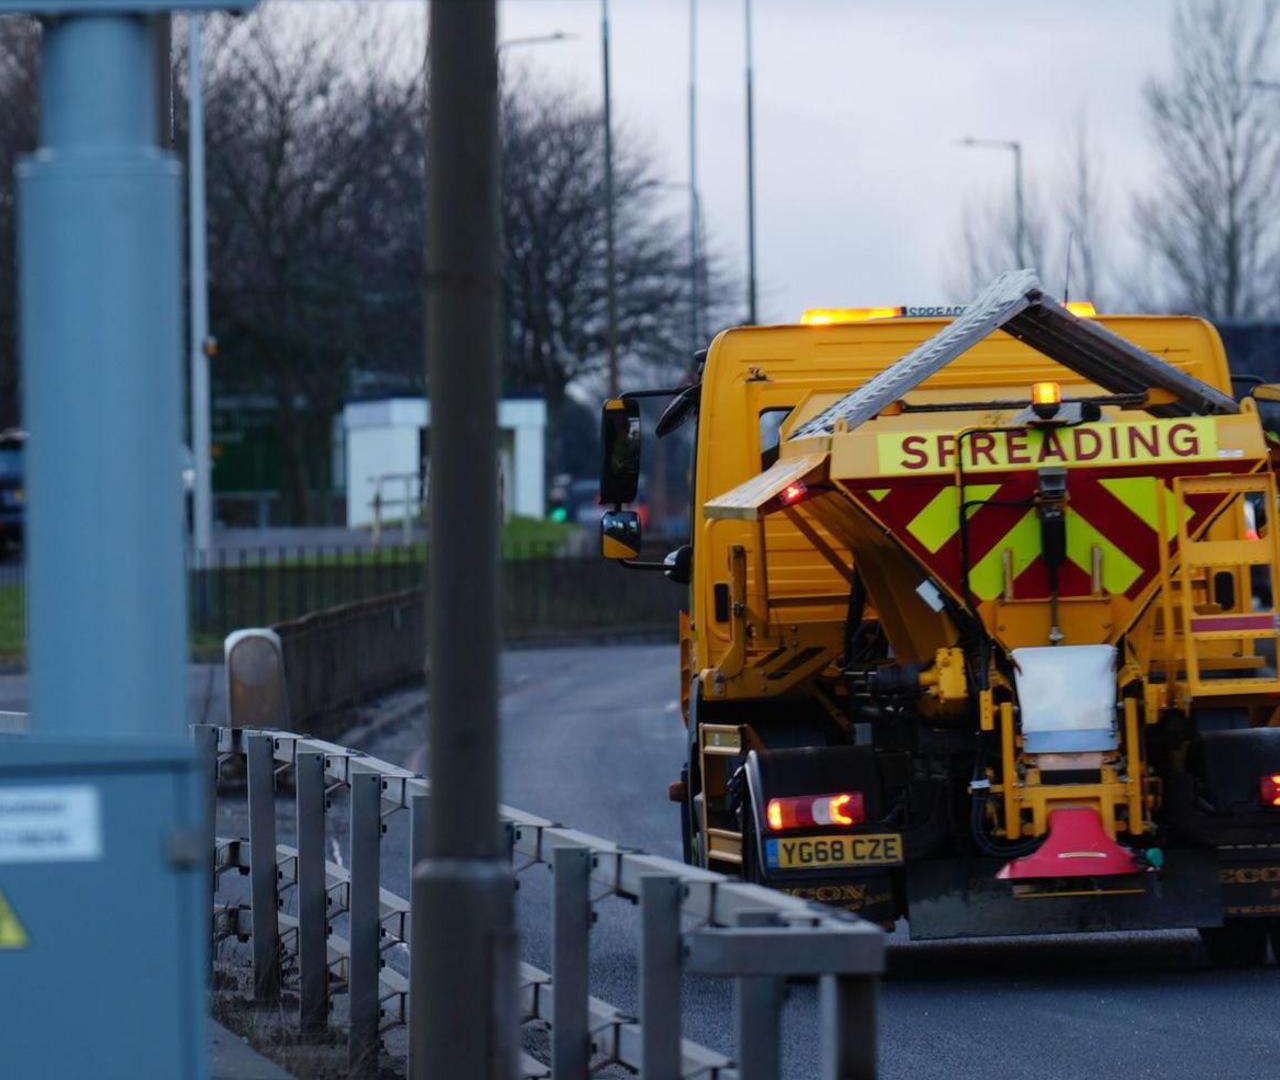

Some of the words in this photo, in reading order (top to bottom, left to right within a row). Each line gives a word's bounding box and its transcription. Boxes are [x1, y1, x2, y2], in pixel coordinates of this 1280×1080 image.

[901, 423, 1200, 470] SPREADING
[782, 840, 845, 864] YG68
[852, 838, 898, 860] CZE
